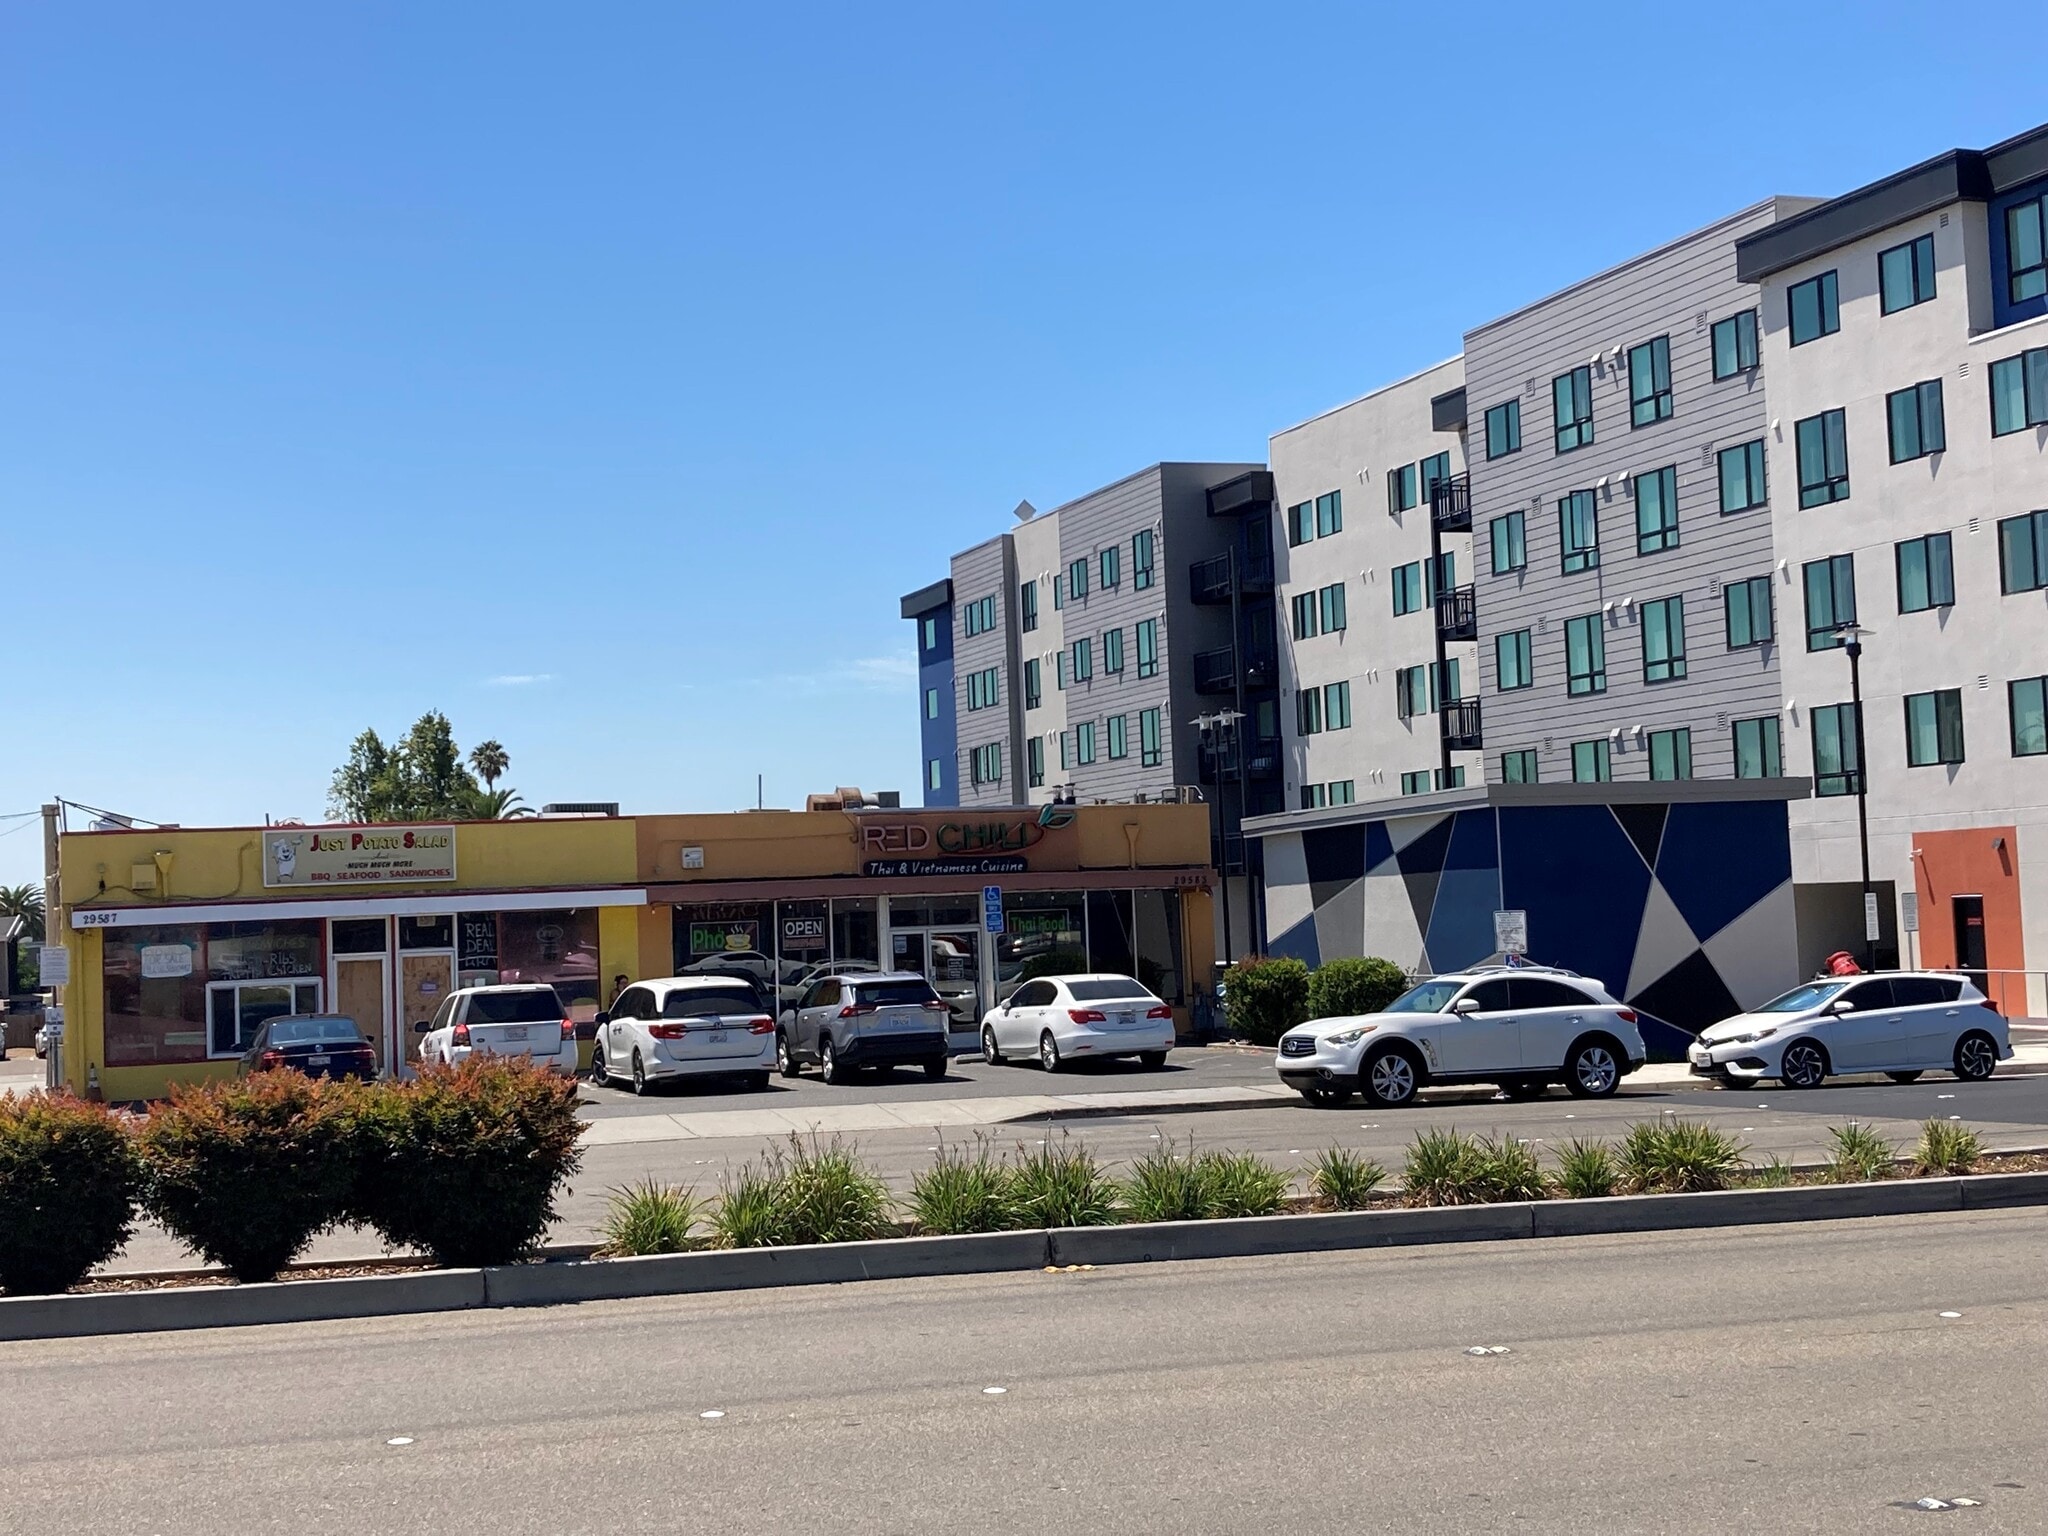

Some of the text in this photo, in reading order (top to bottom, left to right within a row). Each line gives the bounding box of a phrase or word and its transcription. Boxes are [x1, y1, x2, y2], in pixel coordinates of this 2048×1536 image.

[310, 831, 450, 852] JUST POTATO SALAD
[862, 823, 1027, 852] RED CHILI
[348, 861, 369, 869] MUCH
[870, 859, 1024, 875] Thai & Vietnamese Cuisine
[311, 868, 451, 881] BBQ SEAFOOD SANDWICHES
[82, 912, 118, 925] 29587
[464, 922, 495, 938] REAL
[785, 920, 823, 936] OPEN
[465, 938, 496, 954] DEAL
